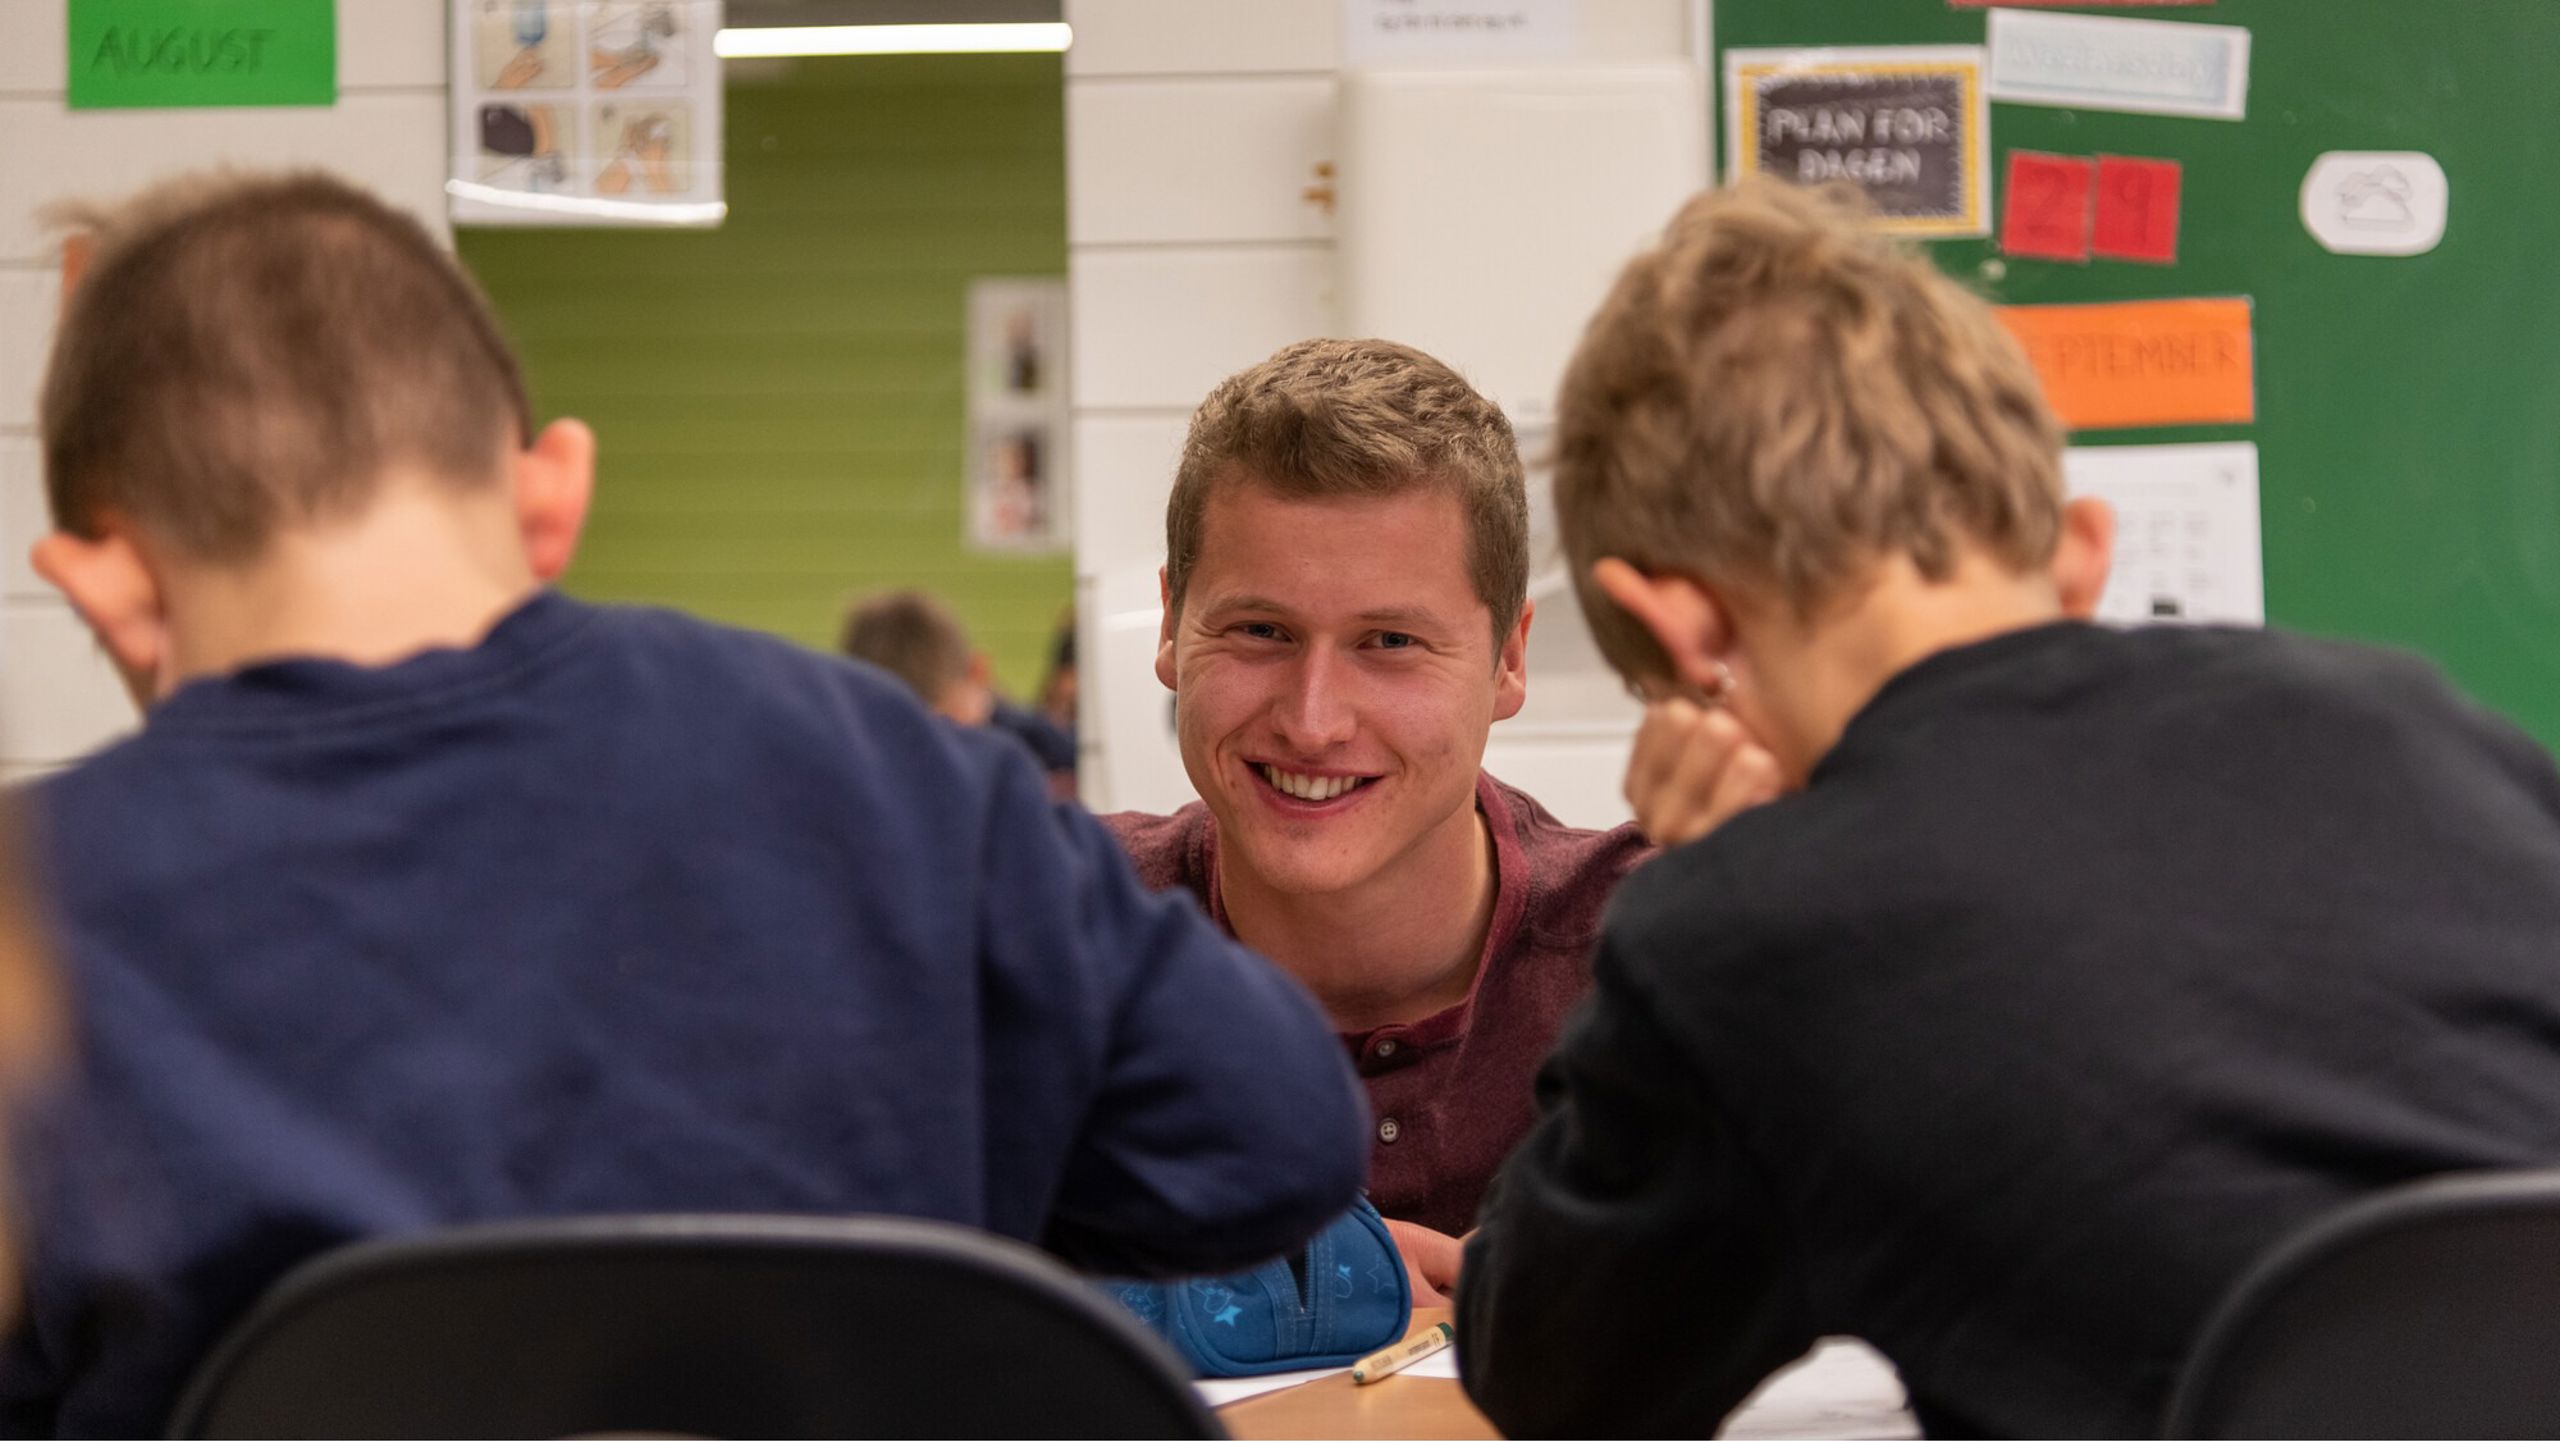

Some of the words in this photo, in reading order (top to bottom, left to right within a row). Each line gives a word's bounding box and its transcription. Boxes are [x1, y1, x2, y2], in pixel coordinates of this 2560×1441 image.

[91, 26, 277, 77] AUGUST
[1766, 107, 1866, 145] PLAN
[1873, 106, 1951, 144] FOR
[1797, 147, 1921, 184] DAGEN
[2024, 330, 2238, 382] EPTEMBER
